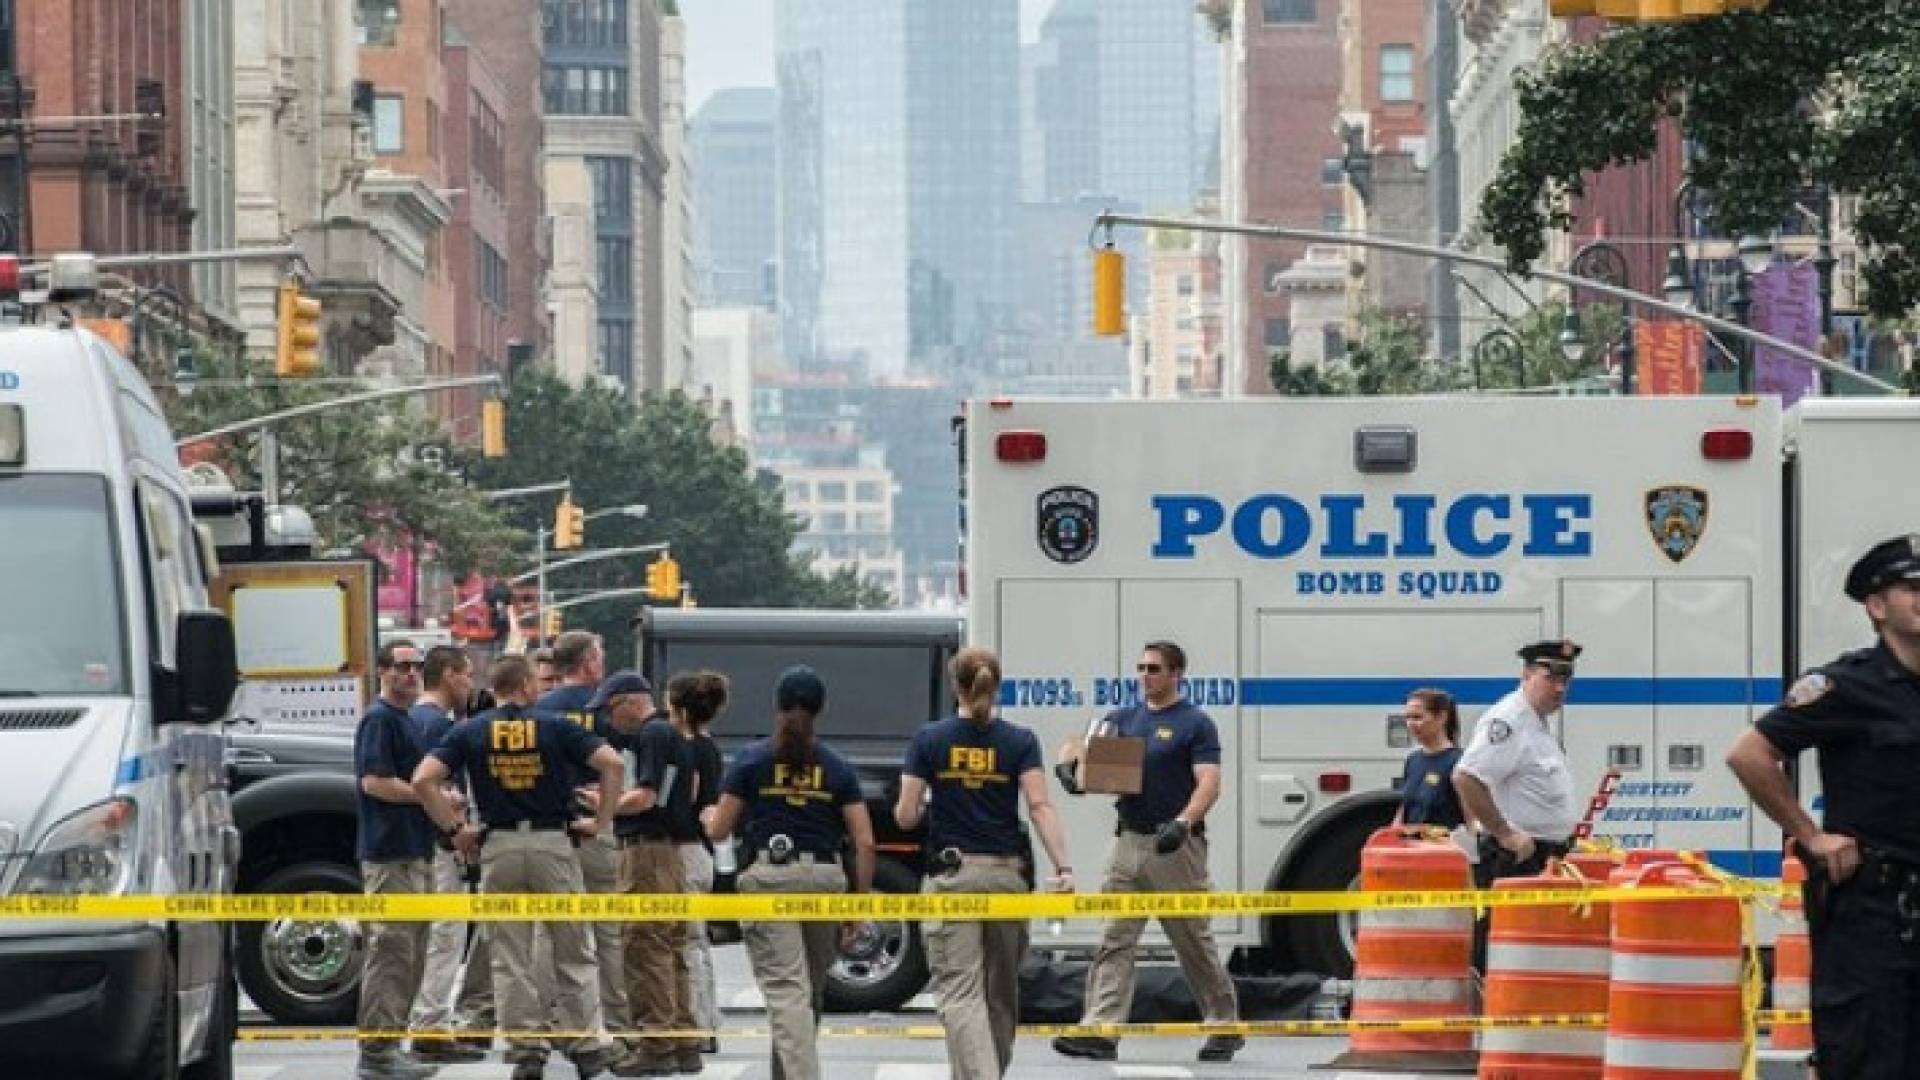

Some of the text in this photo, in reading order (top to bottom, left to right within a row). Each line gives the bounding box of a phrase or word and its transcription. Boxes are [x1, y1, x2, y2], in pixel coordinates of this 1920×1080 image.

[1152, 494, 1591, 558] POLICE
[1296, 572, 1503, 599] BOMB SQUAD
[1093, 678, 1139, 706] BOM
[1177, 678, 1235, 706] QUAD
[492, 719, 536, 750] FBI
[951, 747, 996, 771] FBI
[1599, 770, 1694, 797] COURTESY
